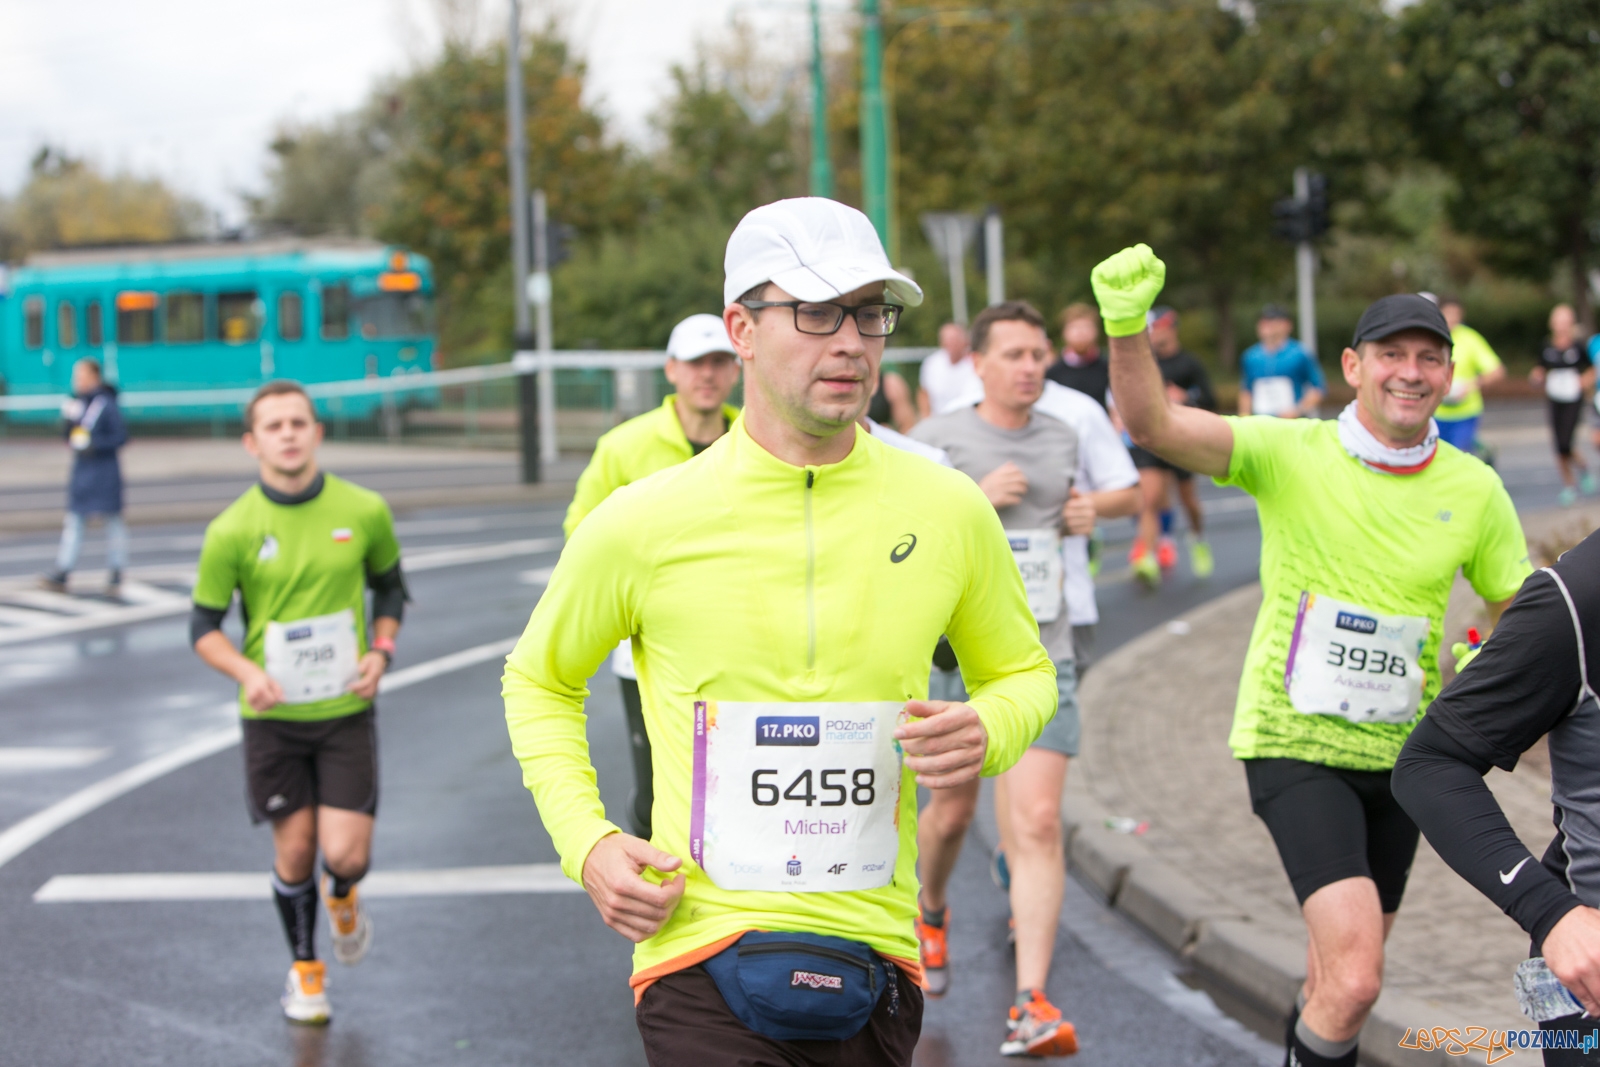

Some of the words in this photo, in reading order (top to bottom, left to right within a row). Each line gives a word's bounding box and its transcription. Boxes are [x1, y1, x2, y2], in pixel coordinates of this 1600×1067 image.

[1327, 641, 1406, 677] 3938
[1334, 674, 1392, 692] Arkadiusz
[761, 724, 815, 738] 17.PKO
[826, 730, 873, 740] maraton
[752, 768, 875, 806] 6458
[785, 819, 847, 834] Michał
